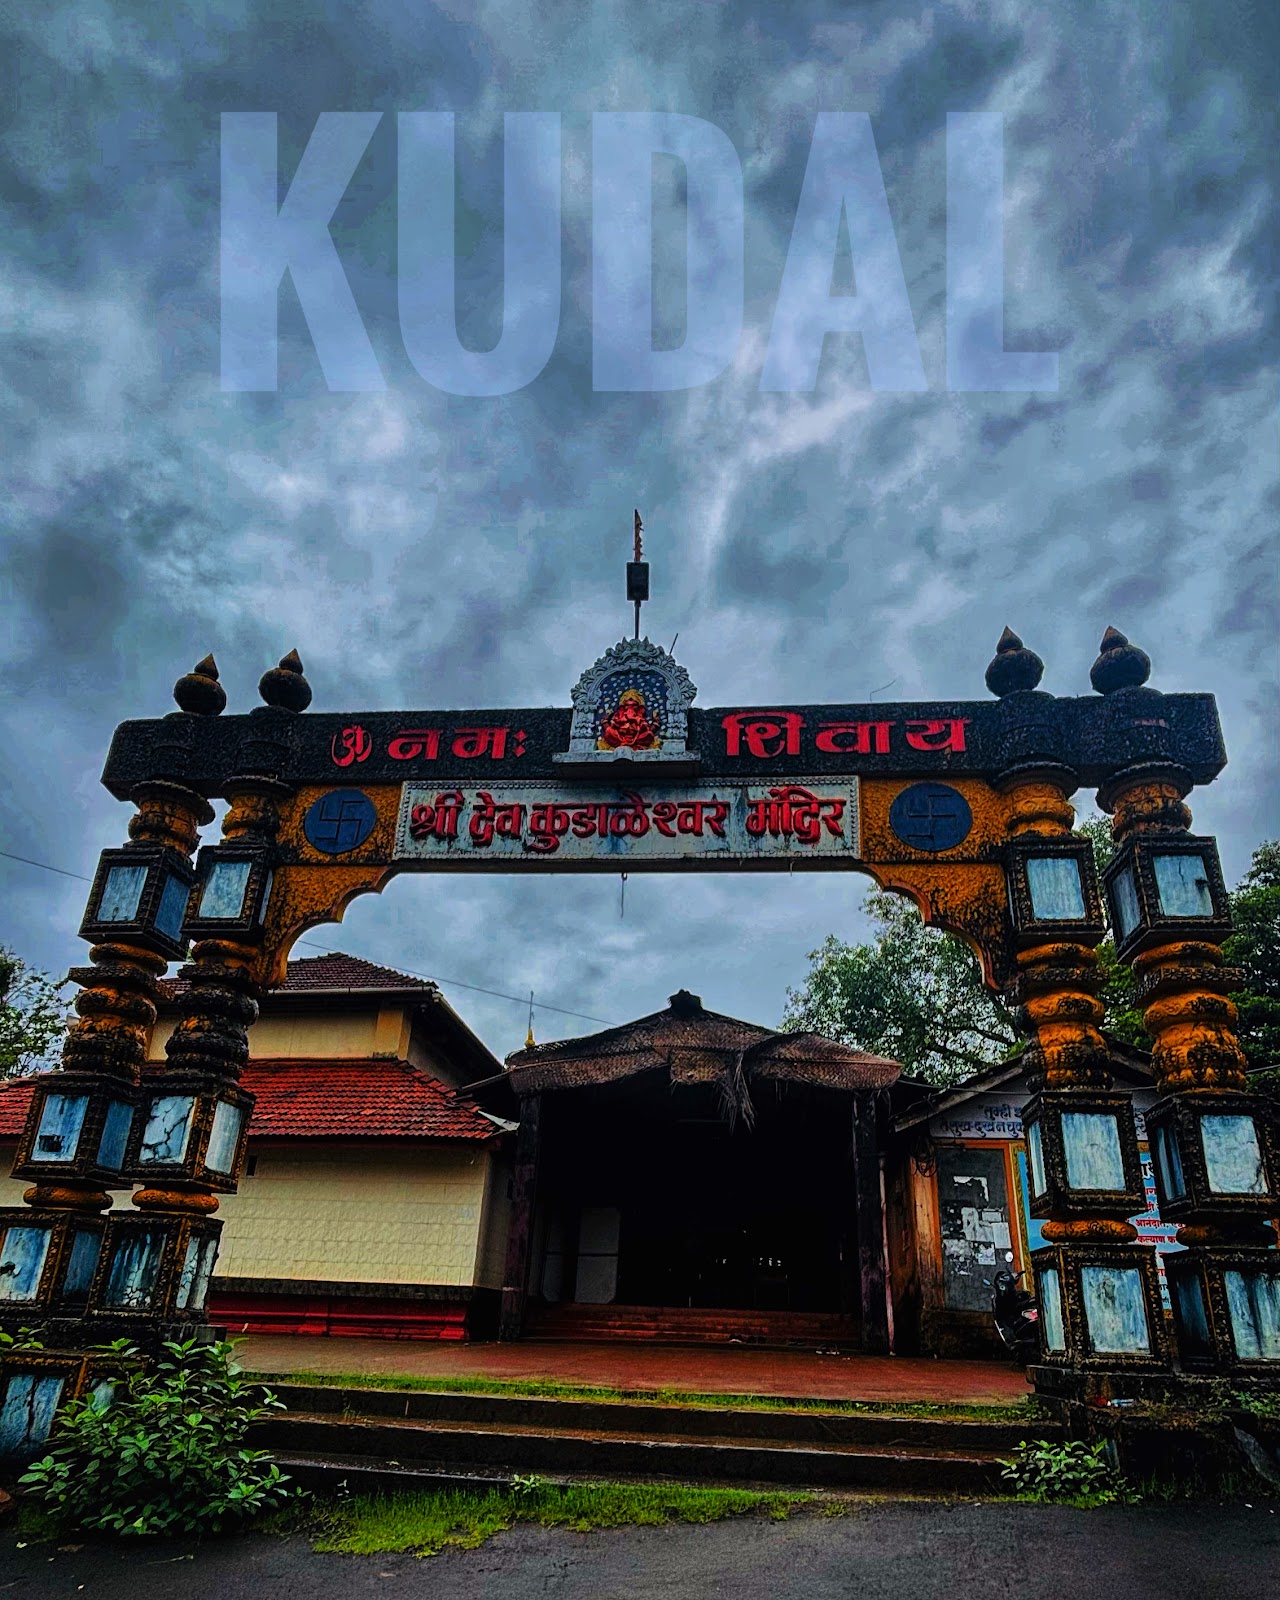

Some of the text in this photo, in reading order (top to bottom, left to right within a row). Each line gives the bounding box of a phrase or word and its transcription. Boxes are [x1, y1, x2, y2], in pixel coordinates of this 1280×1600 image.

[387, 728, 528, 760] नमः
[721, 711, 970, 758] शिवाय
[410, 786, 847, 853] श्री देव कुडाळेश्वर मंदिर
